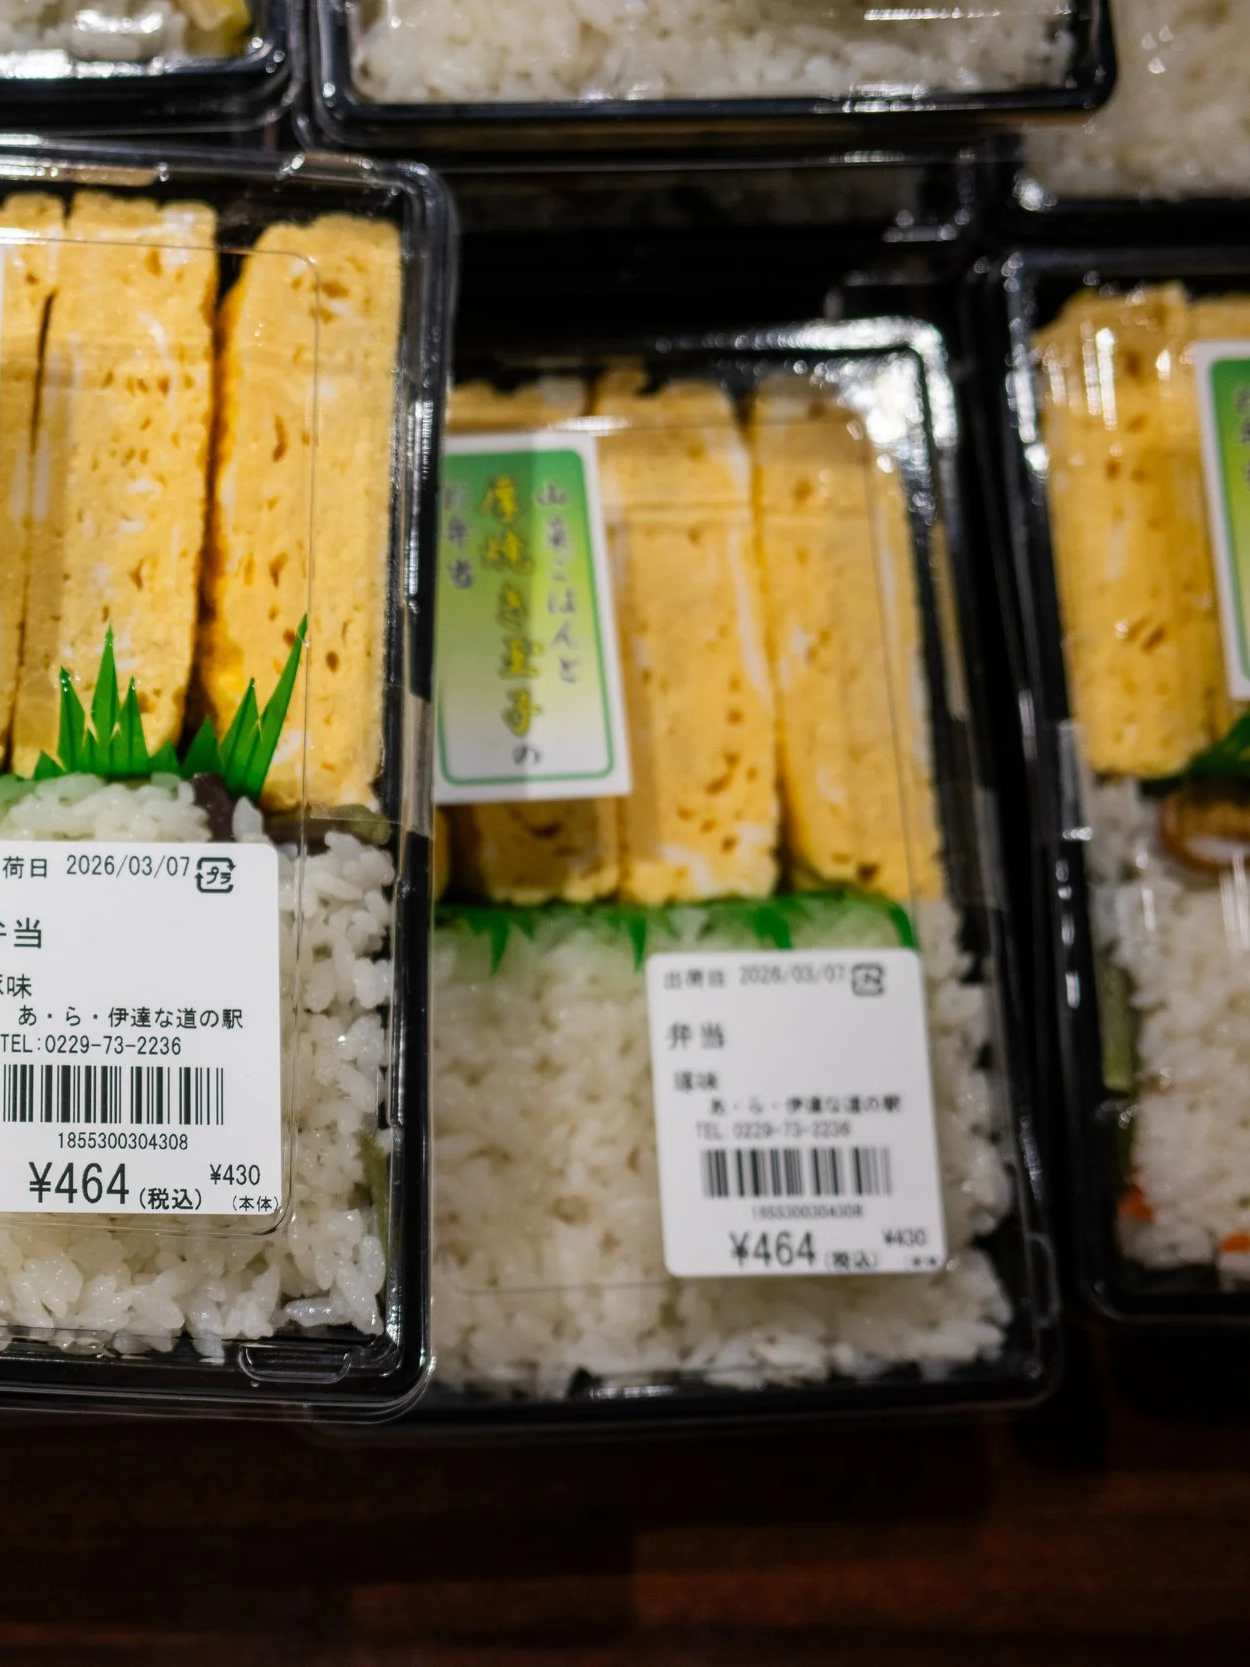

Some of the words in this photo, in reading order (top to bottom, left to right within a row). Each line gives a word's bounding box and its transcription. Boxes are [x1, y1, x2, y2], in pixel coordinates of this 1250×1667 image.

[66, 854, 190, 878] 2026/03/07
[0, 1034, 182, 1056] TEL:0229-73-2236
[667, 1022, 725, 1050] 弁当
[57, 1131, 189, 1151] 1855300304308
[28, 1161, 130, 1205] ¥464
[139, 1187, 203, 1211] (税込)
[209, 1163, 261, 1186] ¥430
[231, 1196, 279, 1212] (本体)
[729, 1229, 816, 1268] ¥464
